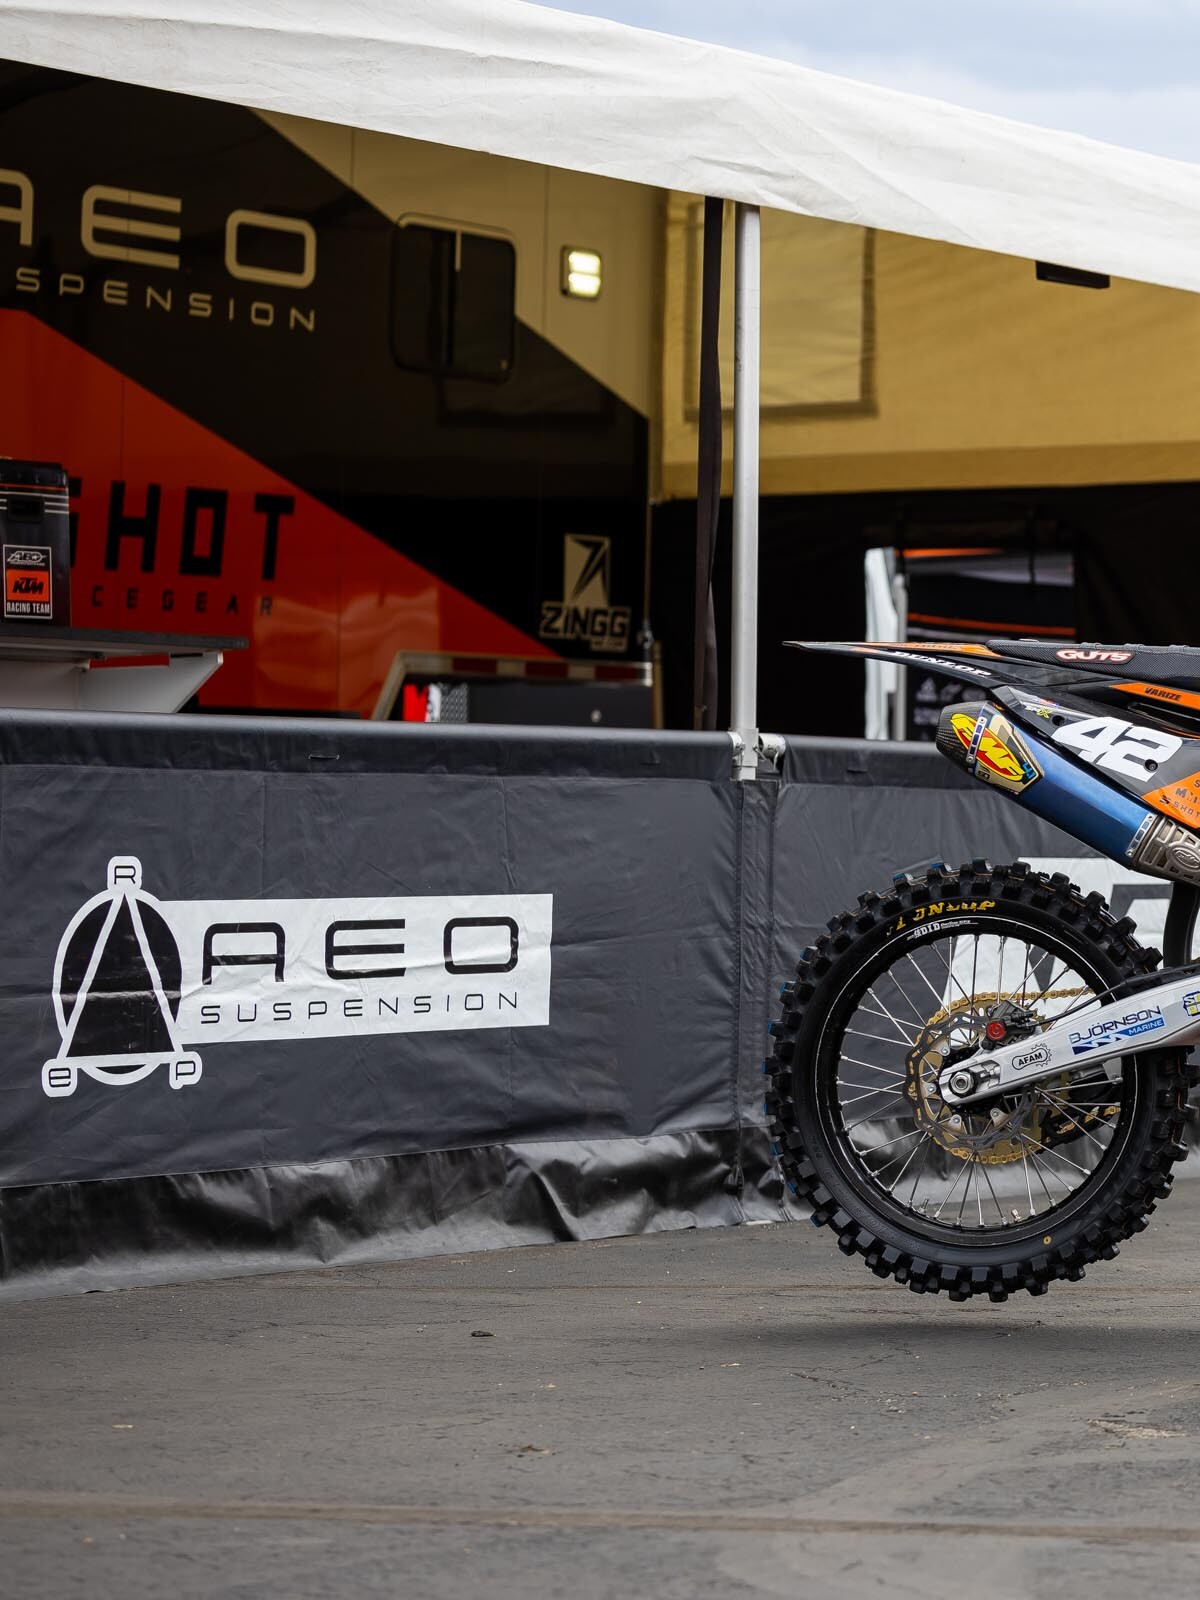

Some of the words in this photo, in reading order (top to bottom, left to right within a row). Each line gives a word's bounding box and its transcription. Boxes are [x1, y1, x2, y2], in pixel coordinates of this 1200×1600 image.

[68, 478, 295, 581] HOT
[13, 577, 43, 594] KTM
[7, 601, 31, 614] RACING
[32, 602, 50, 614] TEAM
[541, 603, 630, 637] ZINGG
[1055, 650, 1134, 663] GUTS
[1144, 686, 1183, 701] VARIZE
[1050, 717, 1183, 782] 42
[1174, 801, 1200, 818] SHOT
[113, 865, 136, 885] R
[920, 922, 941, 936] DID
[201, 916, 519, 985] AEO
[200, 991, 519, 1024] SUSPENSION
[1068, 1005, 1162, 1045] BJÖRNSON
[1128, 1018, 1164, 1036] MARINE
[1018, 1051, 1043, 1068] AFAM
